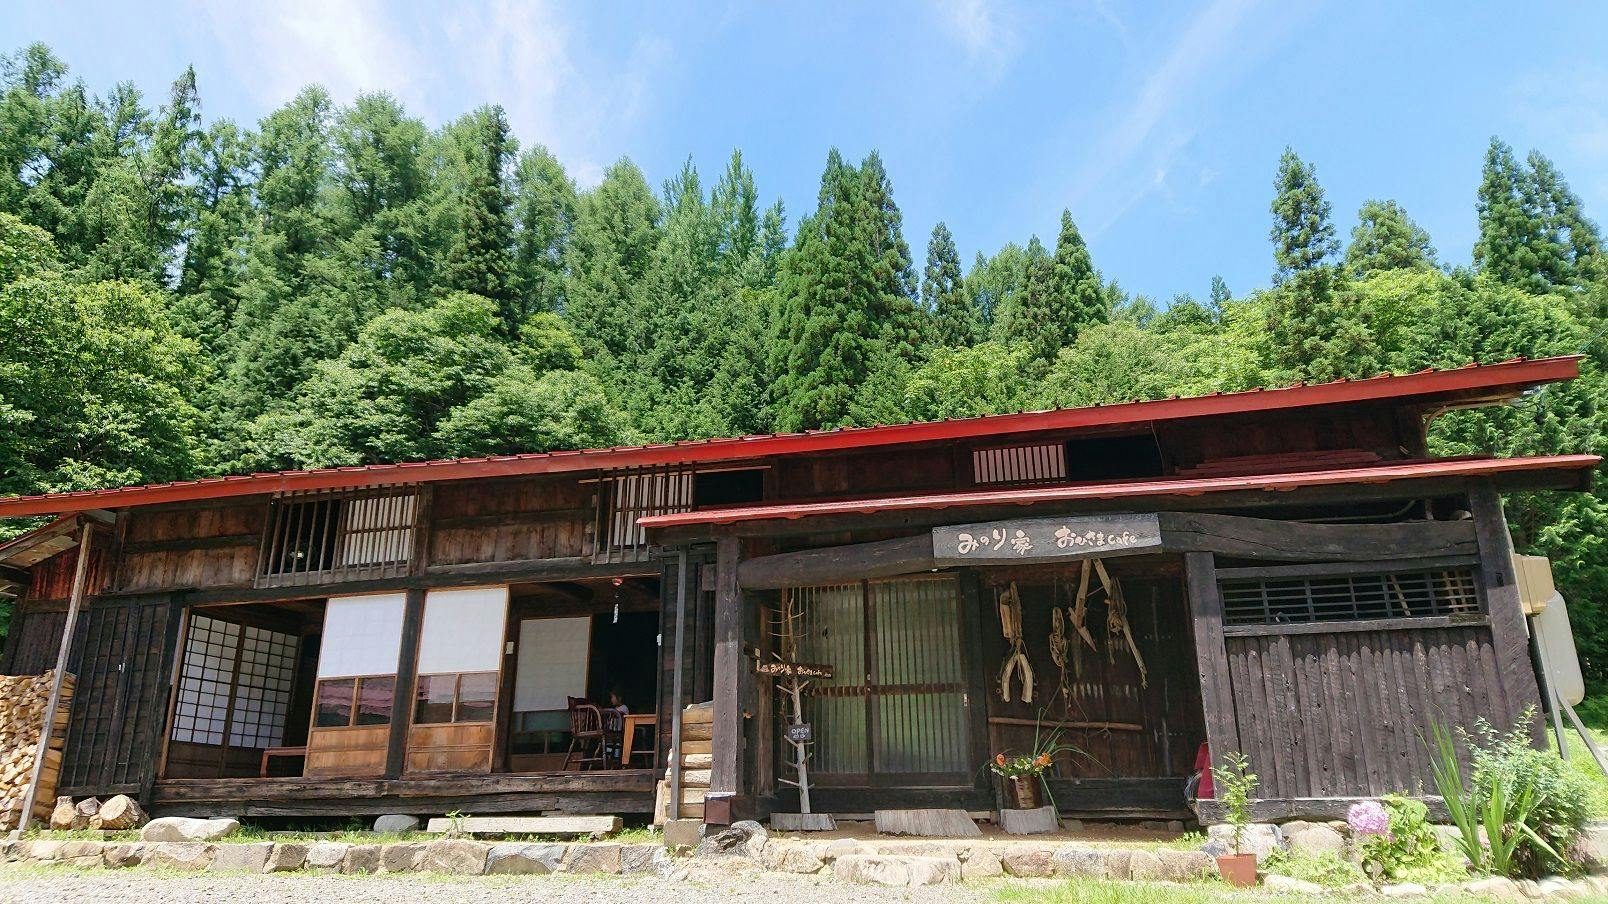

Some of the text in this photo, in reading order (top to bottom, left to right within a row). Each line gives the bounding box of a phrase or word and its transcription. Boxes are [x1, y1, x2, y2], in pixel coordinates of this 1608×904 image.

[957, 528, 1033, 555] みのり家
[791, 727, 809, 735] OPEN
